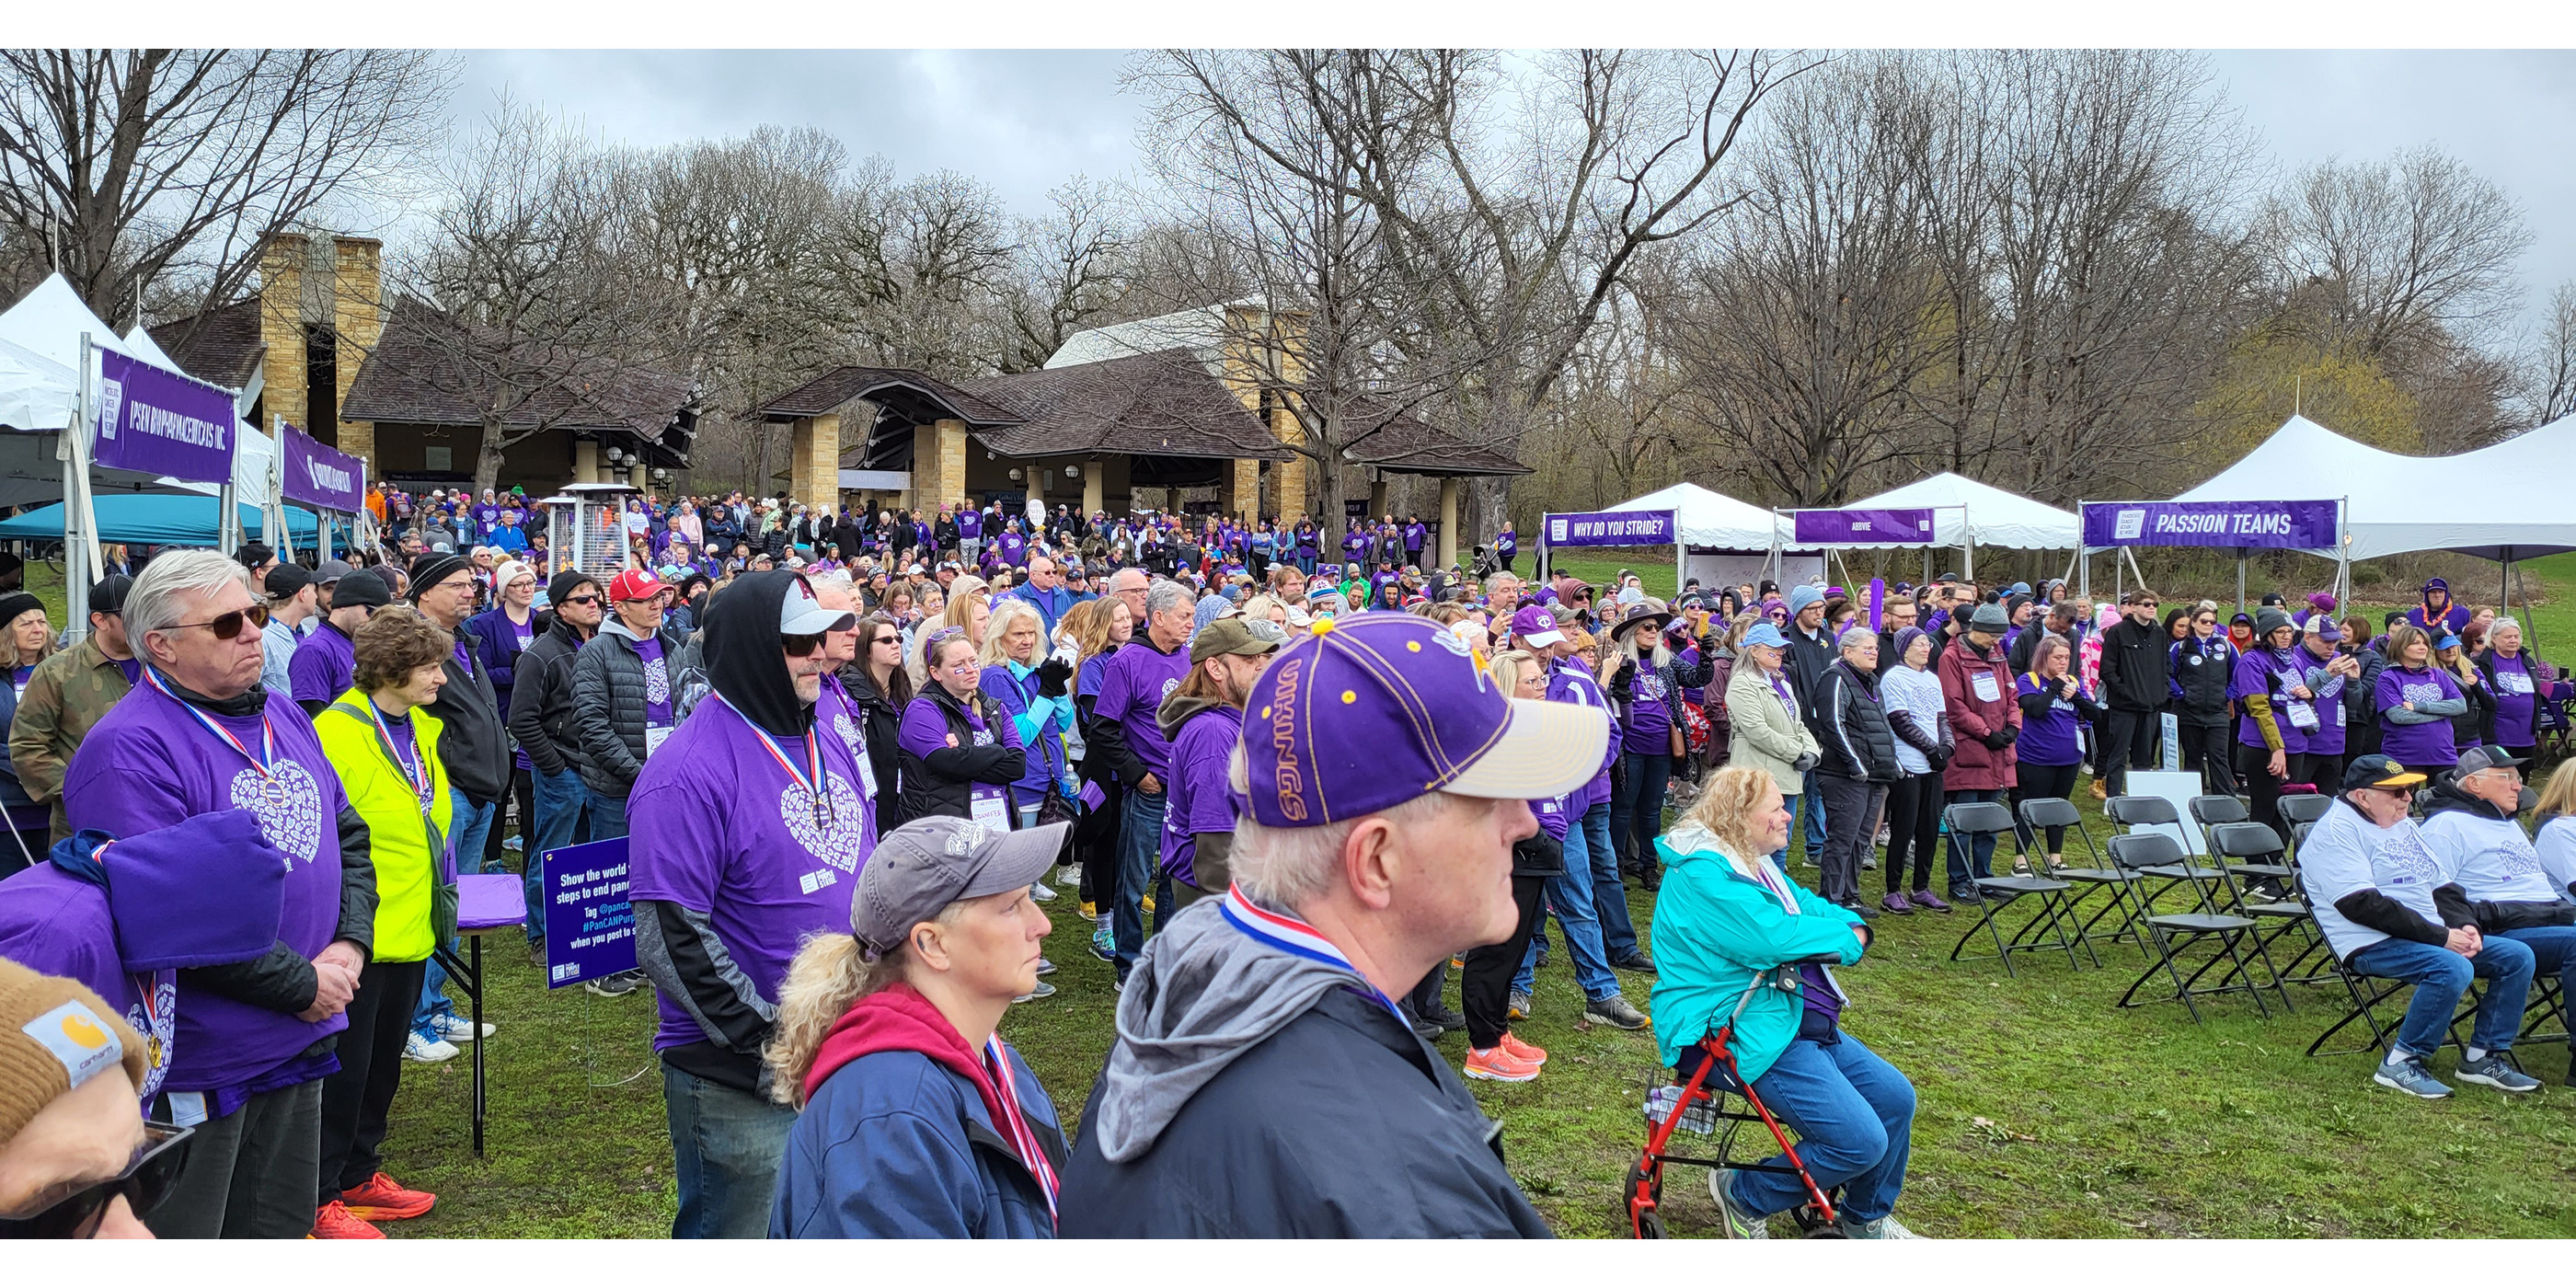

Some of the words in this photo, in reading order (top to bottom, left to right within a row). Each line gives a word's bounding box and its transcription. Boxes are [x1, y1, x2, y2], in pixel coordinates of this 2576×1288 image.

[130, 400, 151, 433] IPSEN
[1574, 523, 1593, 537] WHY
[1593, 522, 1604, 535] DO
[1607, 521, 1625, 535] YOU
[1626, 519, 1663, 535] STRIDE?
[1851, 523, 1871, 531] ABBVIE
[2156, 513, 2228, 534] PASSION
[2233, 513, 2292, 534] TEAMS
[1273, 657, 1308, 821] VIKINGS
[560, 874, 584, 887] Show
[587, 868, 600, 881] the
[602, 863, 626, 880] world
[557, 890, 580, 905] steps
[581, 887, 591, 899] to
[592, 882, 609, 896] end
[584, 907, 596, 918] Tag
[570, 937, 591, 949] when
[592, 935, 605, 947] you
[607, 929, 622, 944] post
[624, 927, 631, 937] to
